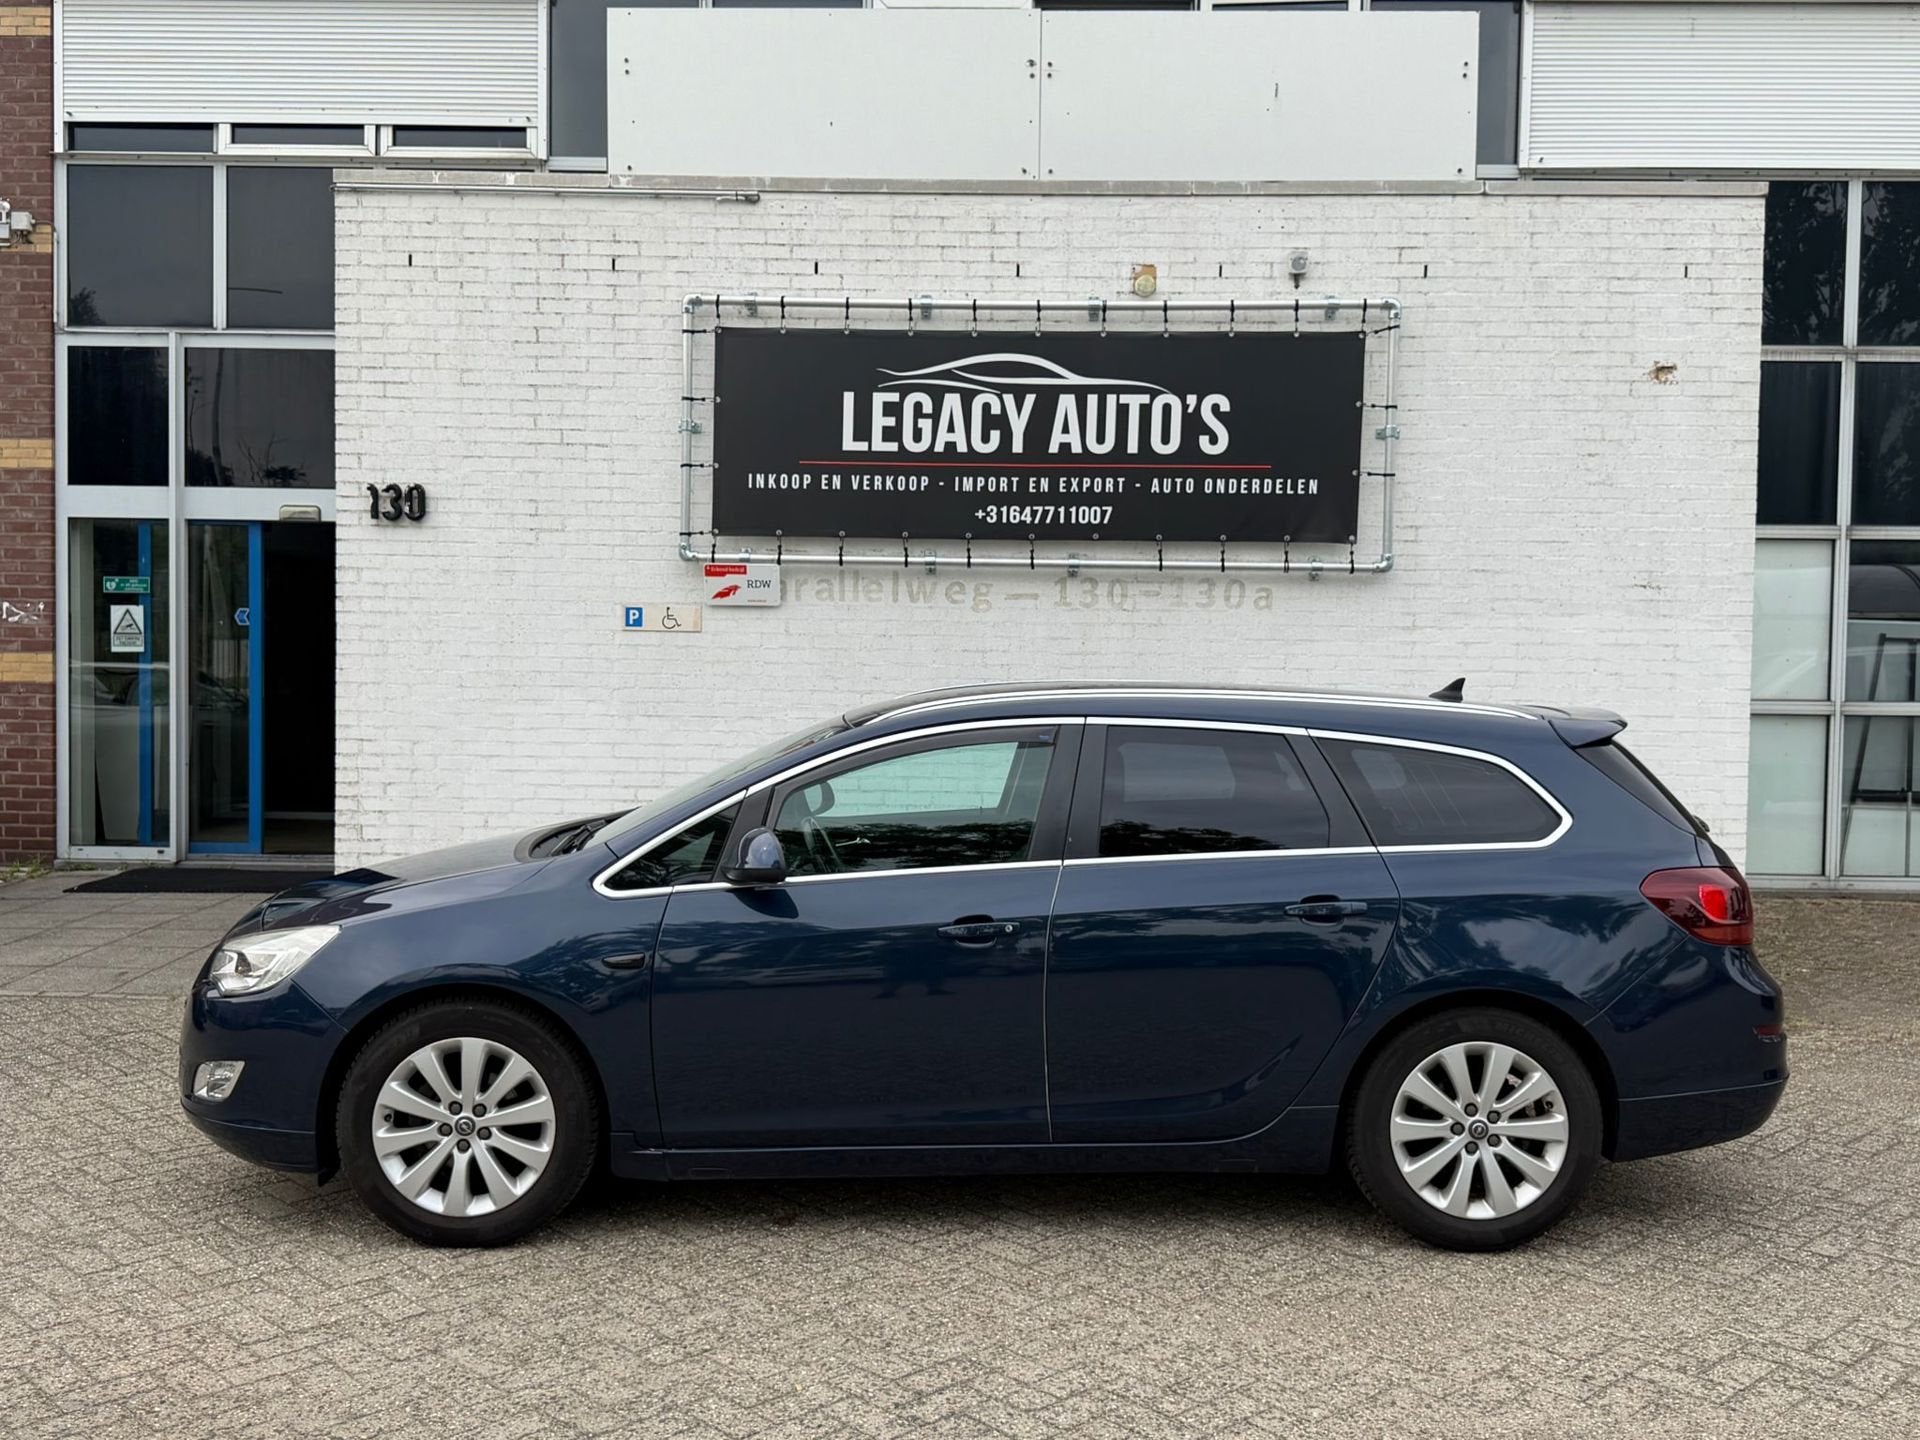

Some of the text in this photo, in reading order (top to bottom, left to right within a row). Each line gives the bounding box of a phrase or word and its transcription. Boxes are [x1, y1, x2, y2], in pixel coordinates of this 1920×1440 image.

[842, 390, 1232, 457] LEGACY AUTO'S
[747, 472, 812, 490] INKOOP
[821, 474, 841, 490] EN
[851, 474, 929, 492] VERKOOP
[954, 476, 1020, 493] IMPORT
[1028, 477, 1049, 493] EN
[1059, 476, 1126, 493] EXPORT
[1150, 477, 1195, 494] AUTO
[1204, 477, 1318, 496] ONDERDELEN
[366, 482, 427, 523] 130
[974, 504, 1113, 525] +31647711007
[747, 579, 772, 589] RDW
[629, 609, 639, 624] P
